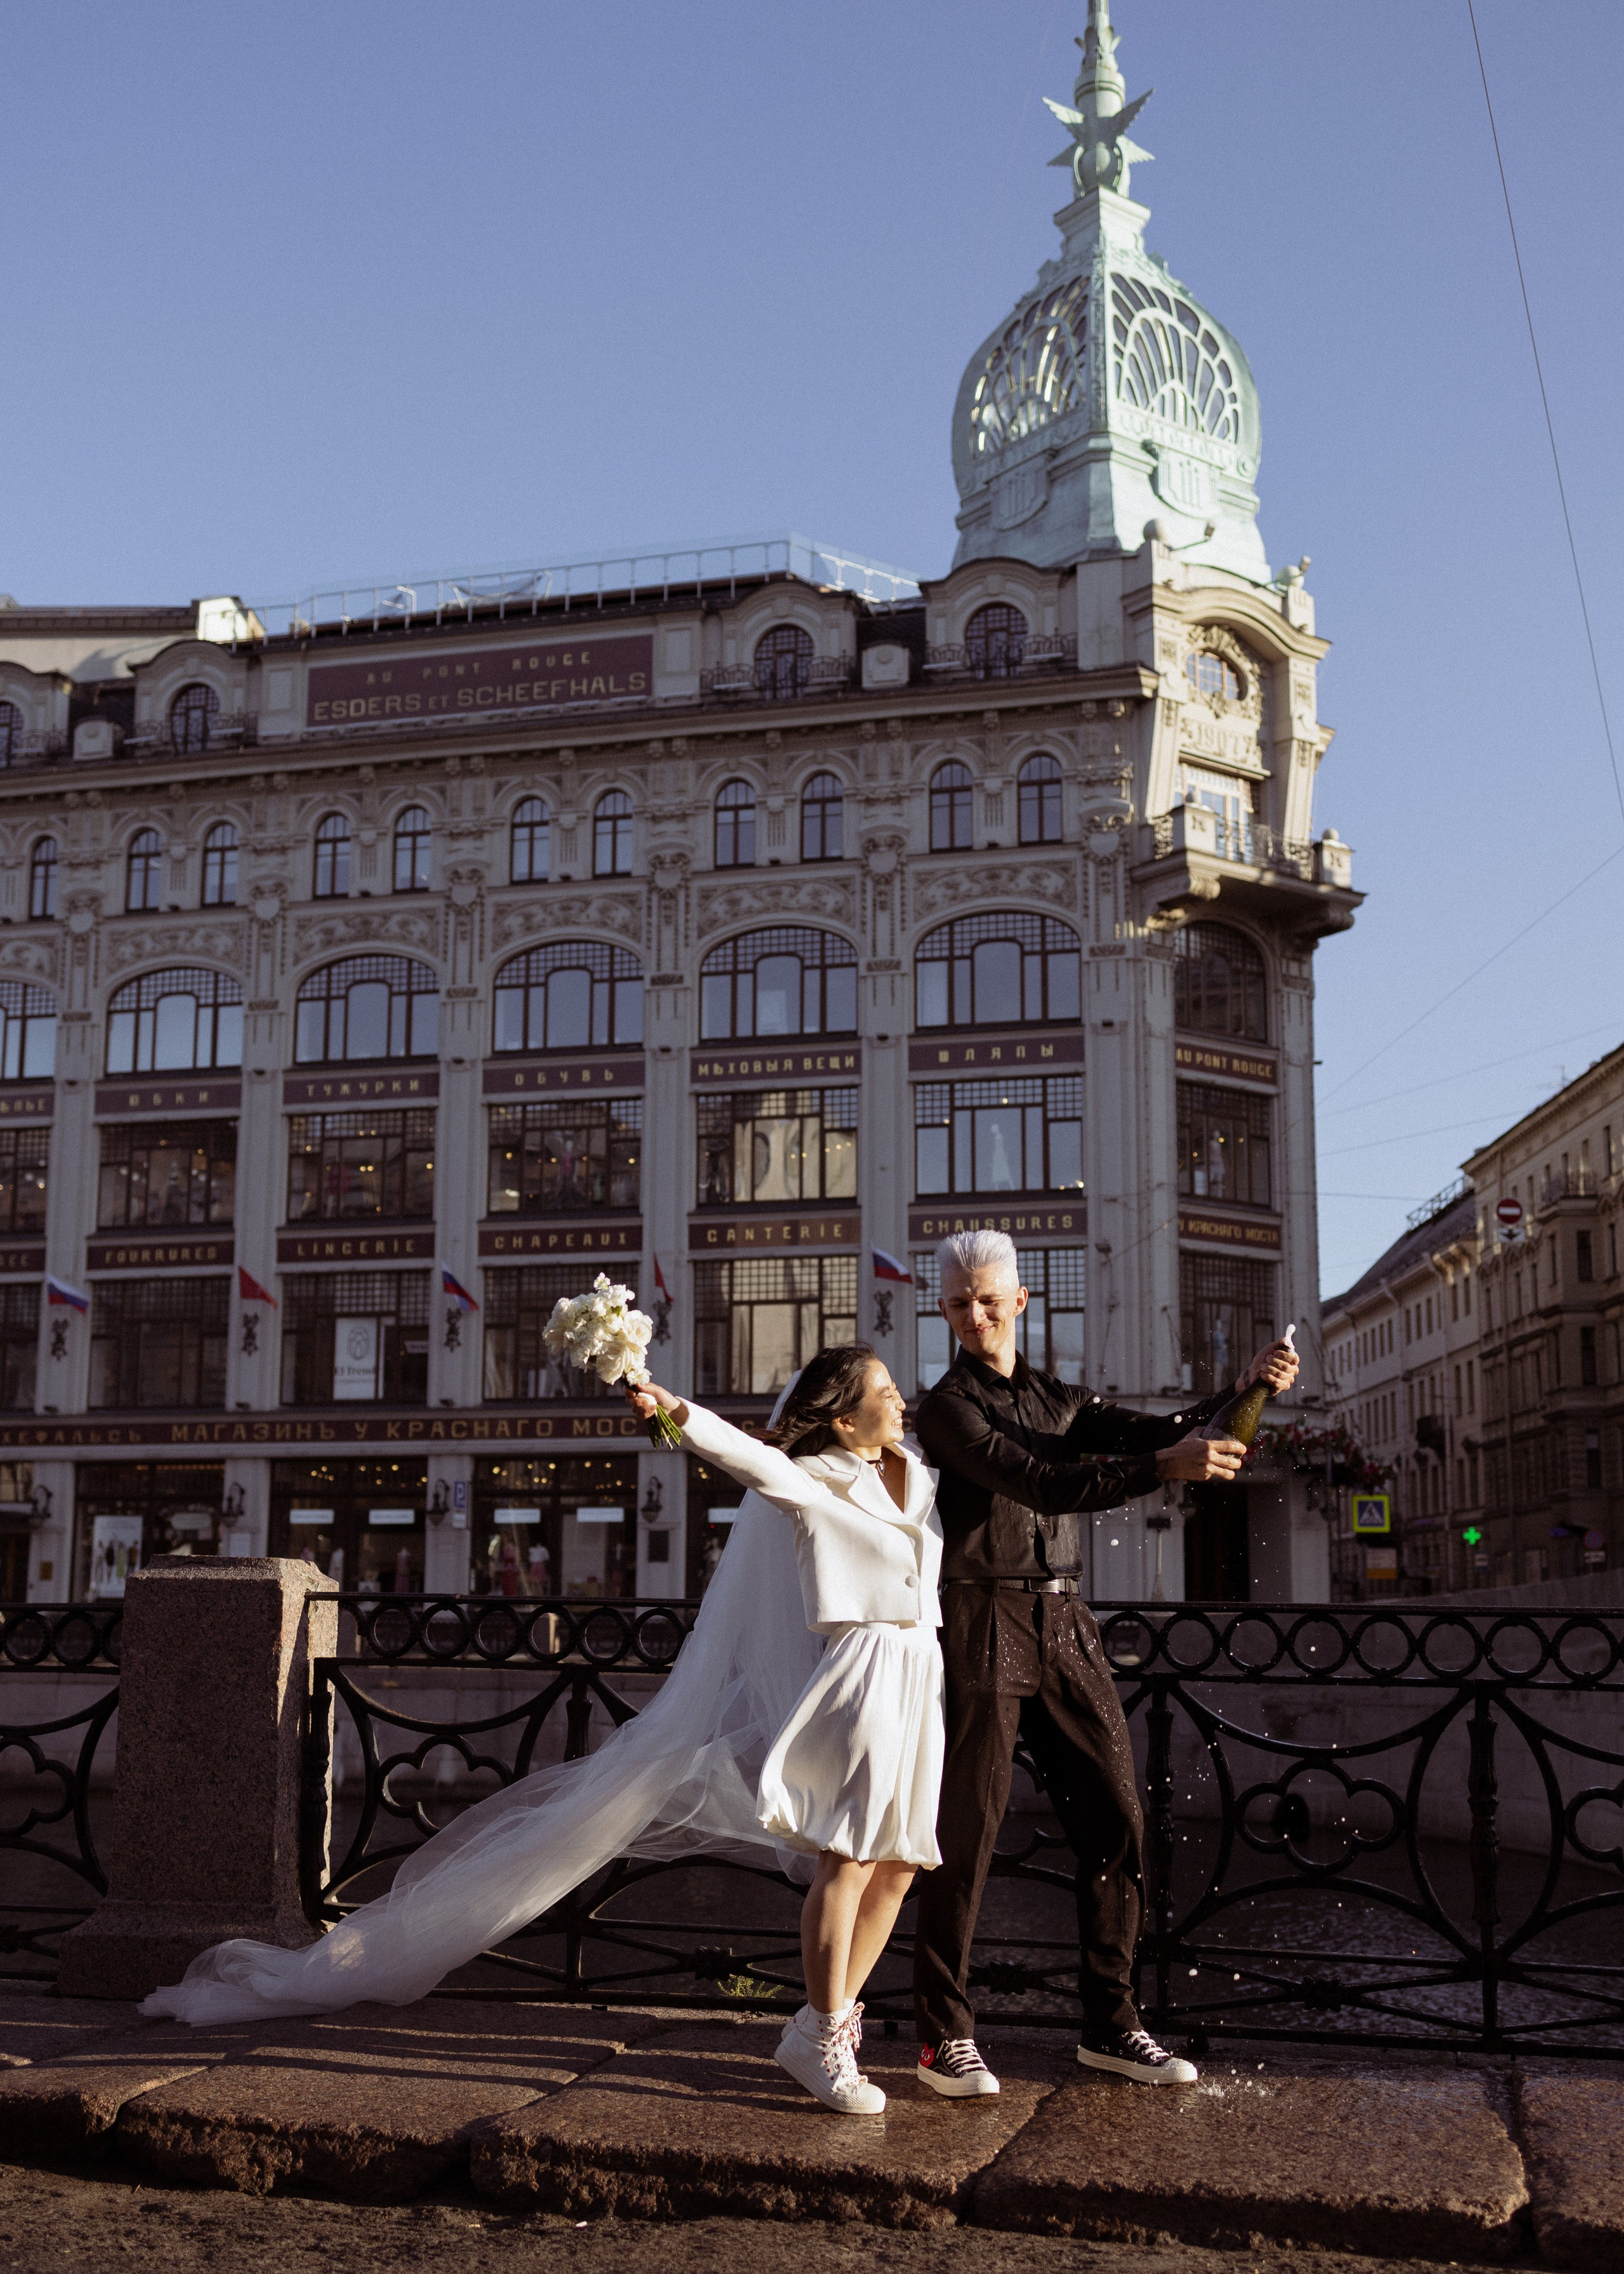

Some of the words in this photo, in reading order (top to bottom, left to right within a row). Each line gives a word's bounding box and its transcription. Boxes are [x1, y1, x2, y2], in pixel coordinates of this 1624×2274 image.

[367, 671, 393, 685] AU
[422, 662, 480, 679] PONT
[513, 651, 591, 671] ROUGE
[313, 693, 422, 721] ESDERS
[428, 693, 449, 709] ET
[457, 671, 646, 707] SCHEEFHALS
[802, 1055, 855, 1070] ВЕЩИ
[938, 1044, 1054, 1063] ШЛЯПЫ
[1175, 1048, 1192, 1063] AU
[1195, 1051, 1228, 1070] PONT
[1232, 1058, 1273, 1078] ROUGE
[514, 1068, 614, 1086] ОБУВЬ
[306, 1079, 420, 1098] ТУЖУРКИ
[129, 1091, 209, 1107] ЮБКИ
[707, 1223, 842, 1242] CANTERIE
[923, 1214, 1073, 1234] CHAUSSURES
[297, 1238, 414, 1256] LINGERIE
[494, 1232, 626, 1249] CHAPEAUX
[105, 1245, 217, 1264] FOURRURES
[171, 1421, 336, 1442] МАГАЗИНЪ
[355, 1421, 369, 1440] У
[386, 1418, 554, 1440] КРАСНАГО
[573, 1416, 637, 1436] МОС
